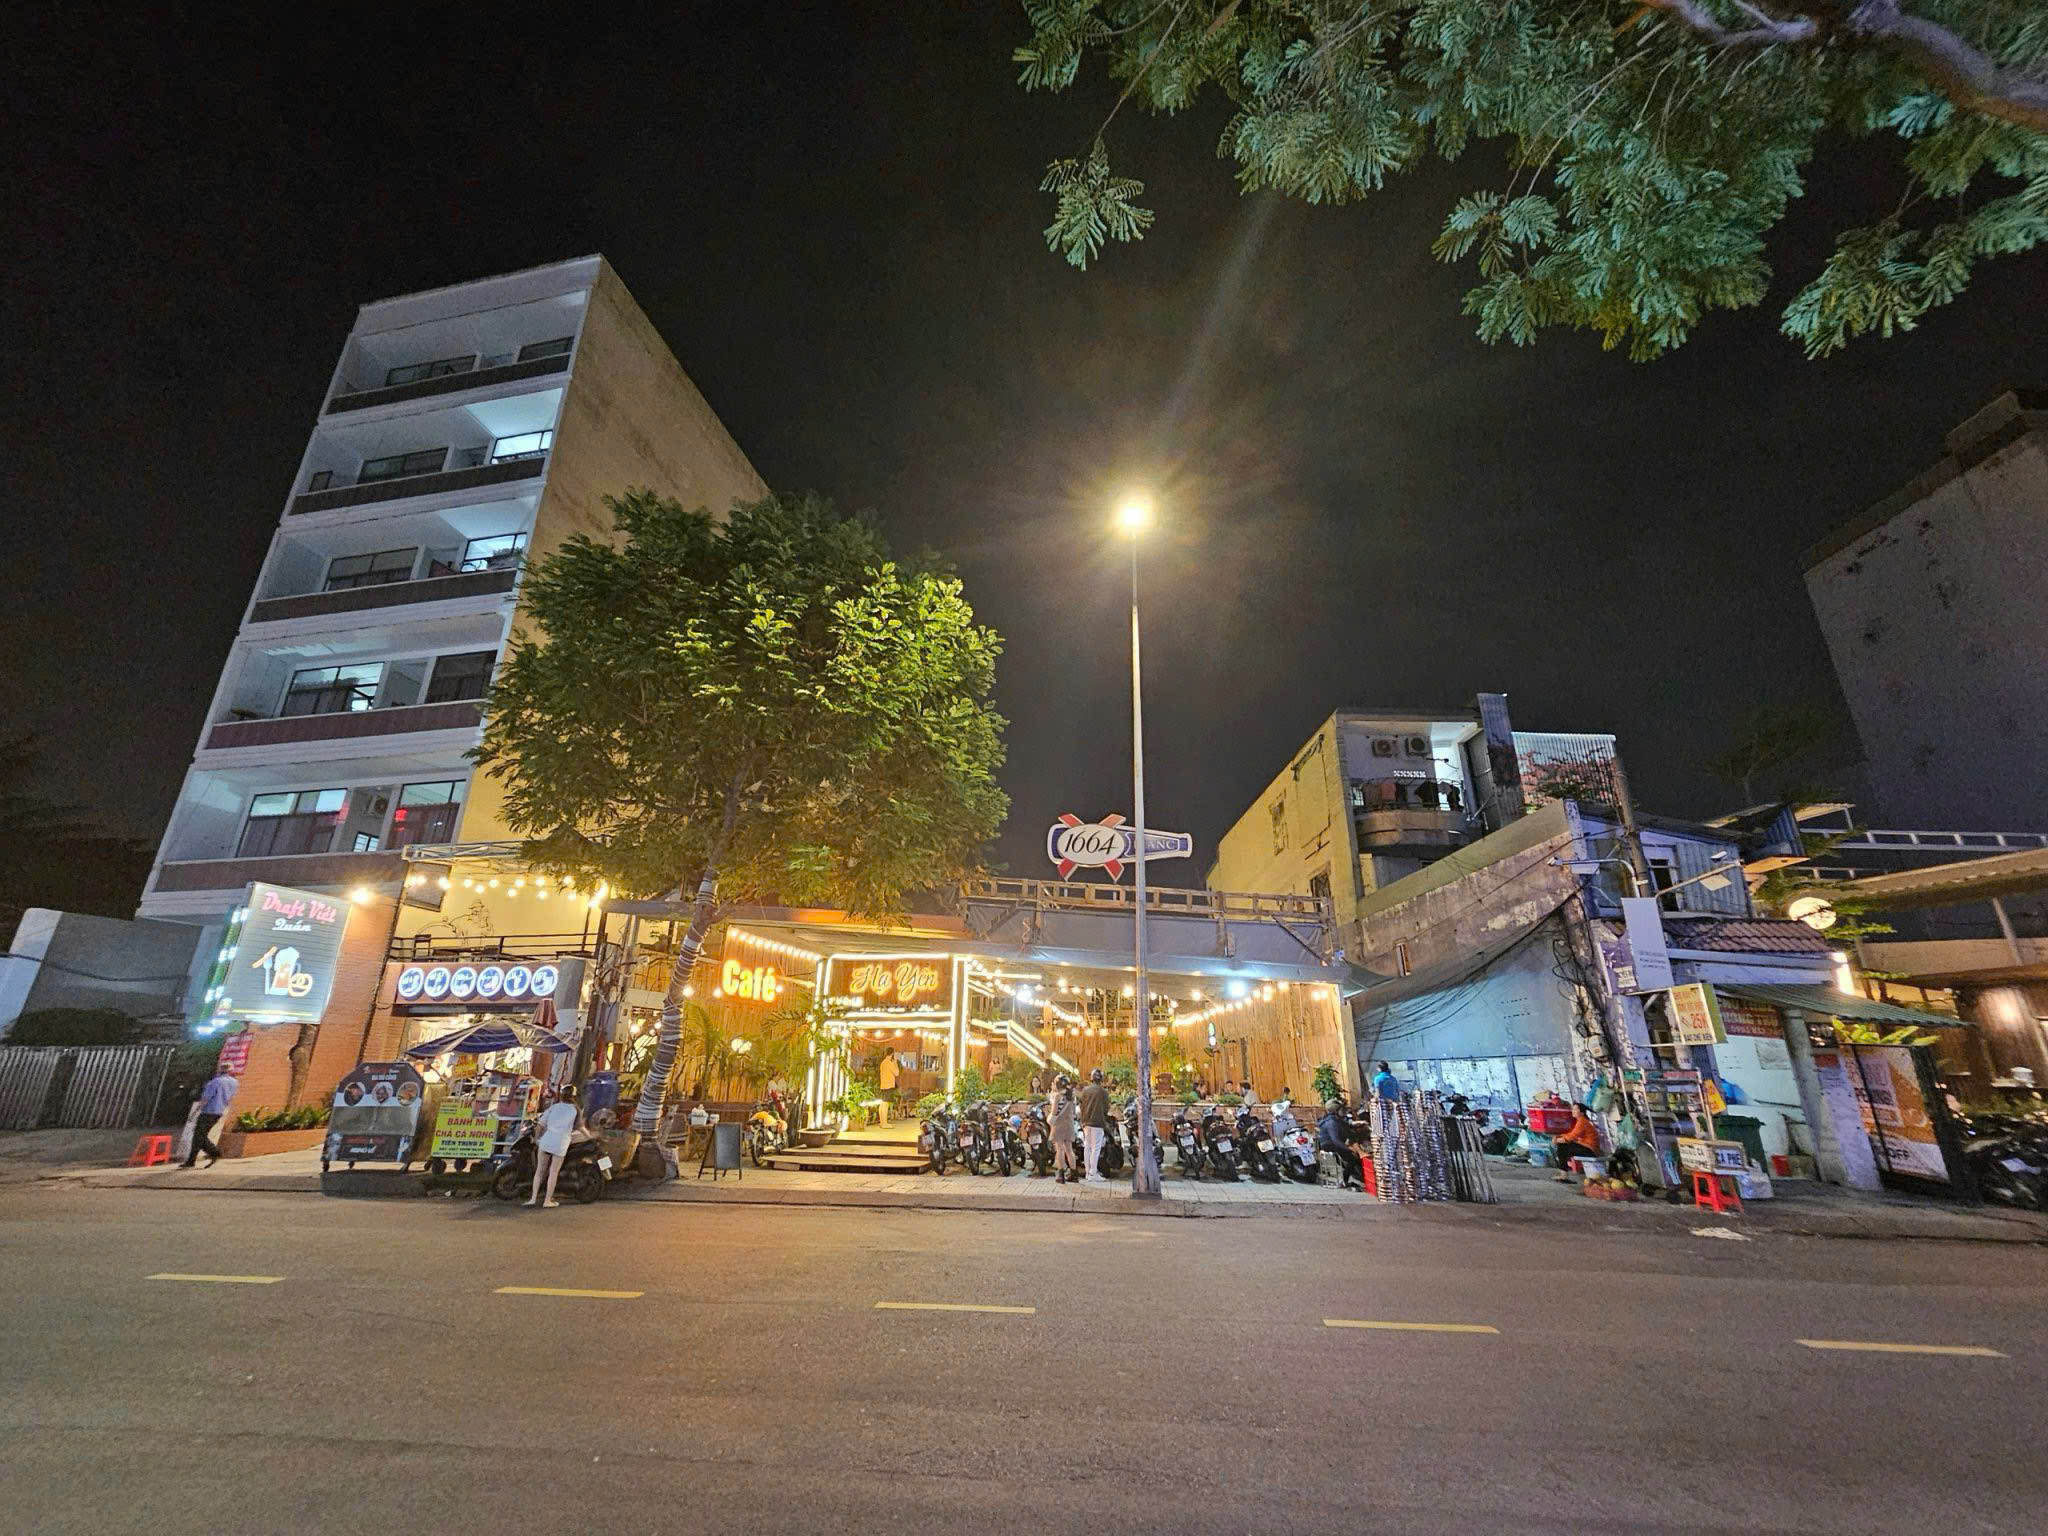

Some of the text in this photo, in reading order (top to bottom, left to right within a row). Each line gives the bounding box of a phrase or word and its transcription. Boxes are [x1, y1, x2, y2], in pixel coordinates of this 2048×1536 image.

[1064, 829, 1119, 855] 1664
[262, 891, 305, 919] Draft
[722, 959, 776, 1003] Café
